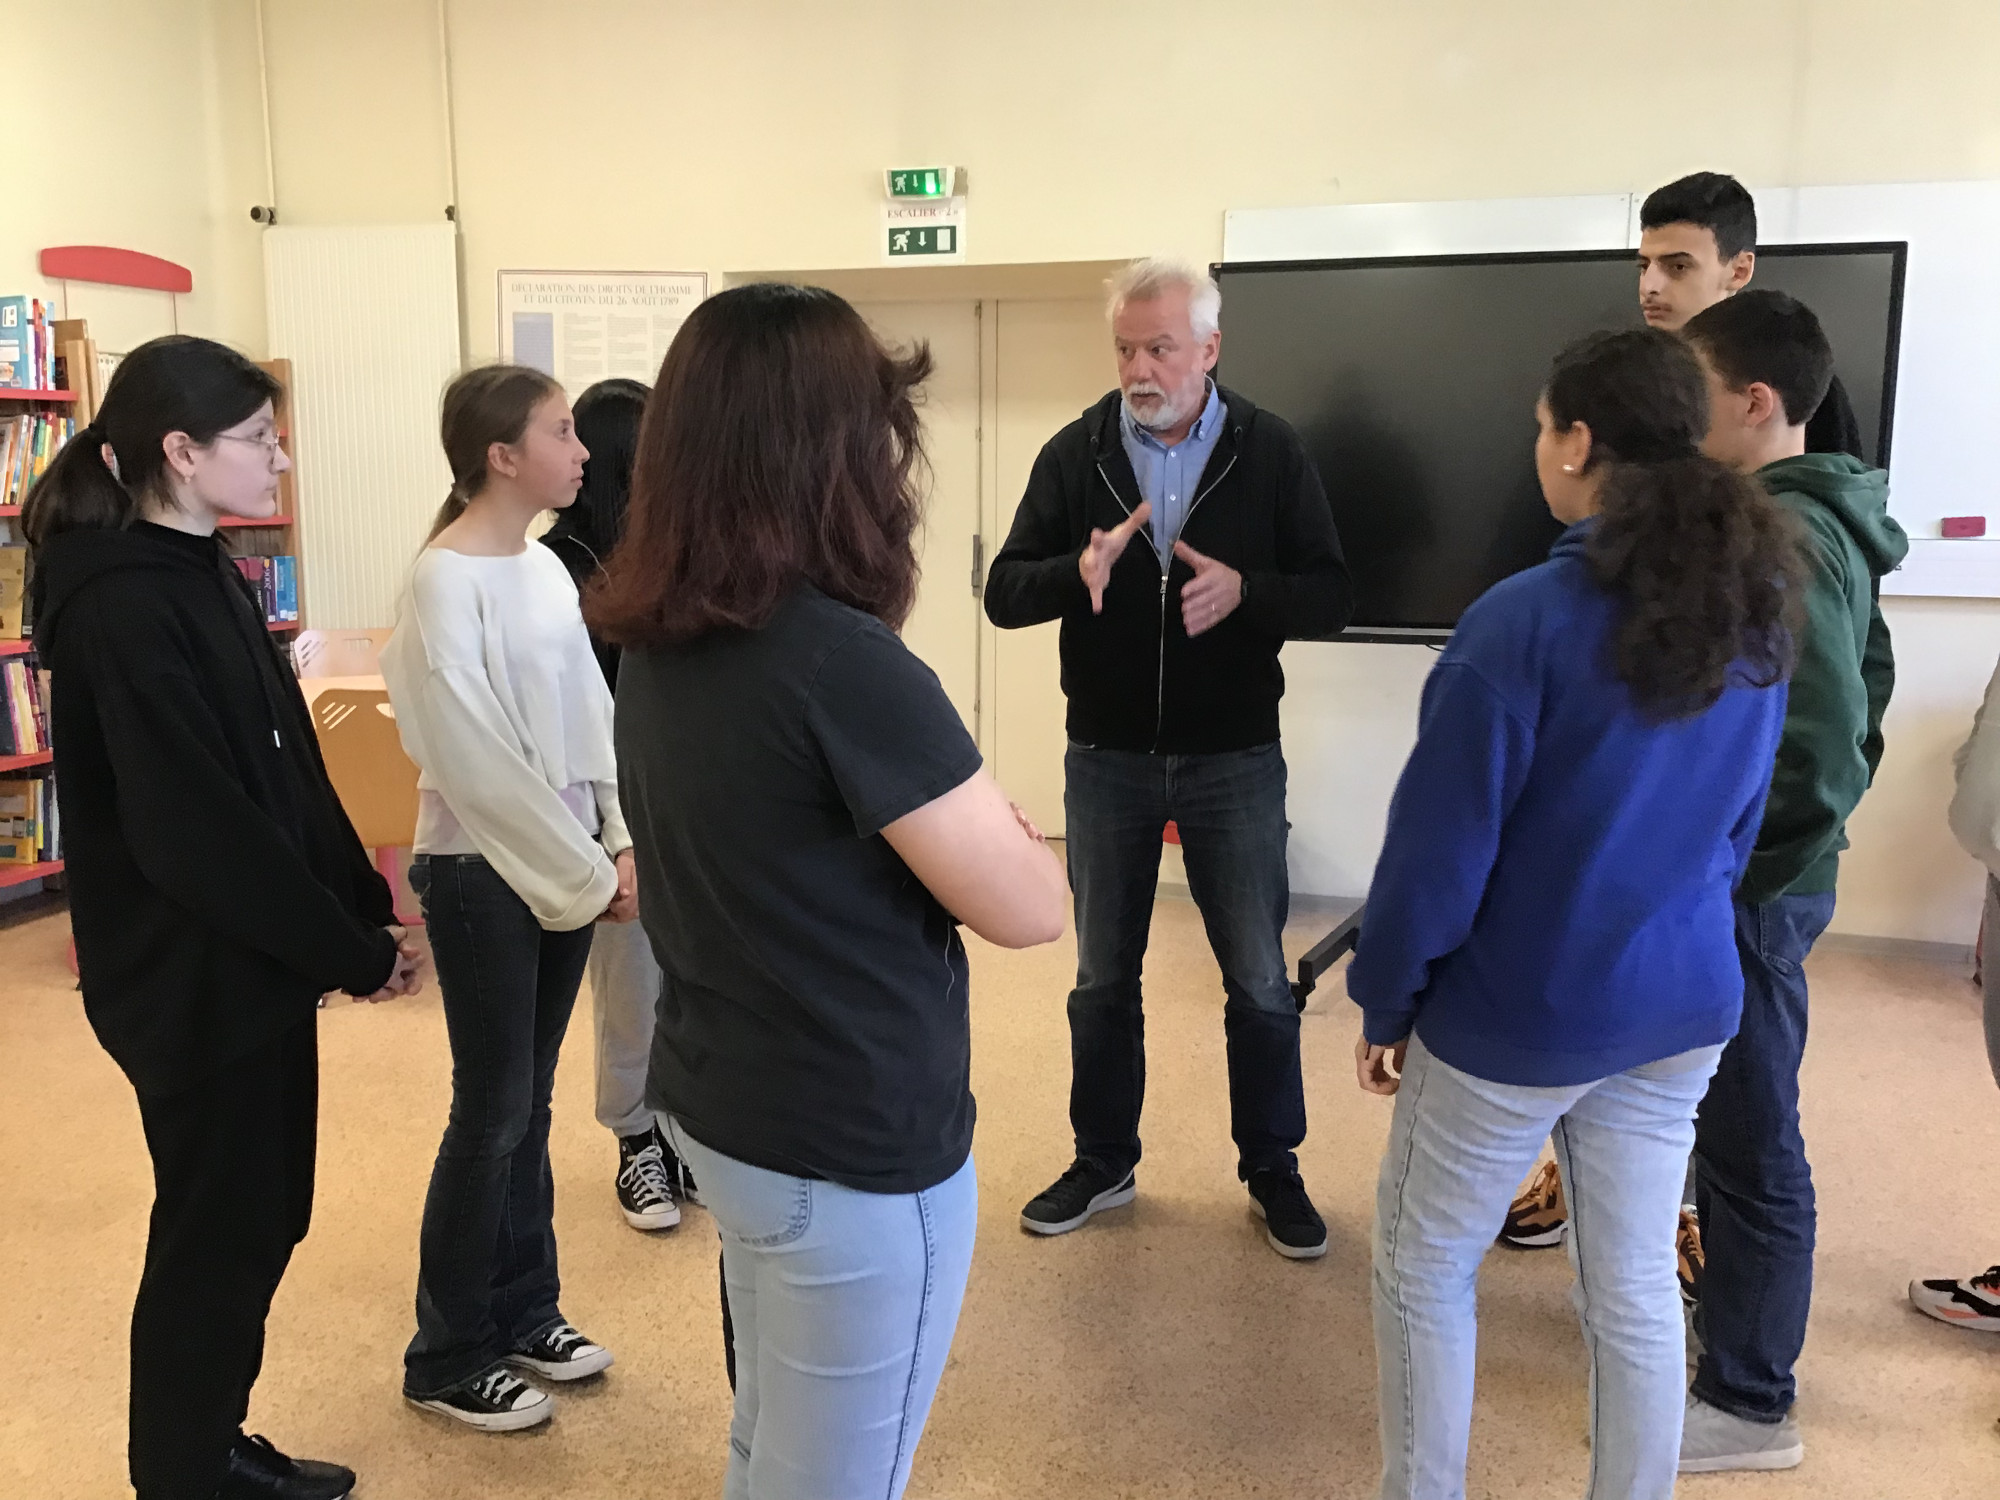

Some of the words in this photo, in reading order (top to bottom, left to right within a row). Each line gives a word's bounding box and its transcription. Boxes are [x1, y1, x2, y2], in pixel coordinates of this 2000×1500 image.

[887, 207, 936, 218] ESCALIER
[578, 284, 595, 294] DES
[597, 284, 632, 294] DROITS
[635, 284, 646, 294] DE
[524, 294, 534, 304] ET
[538, 294, 552, 304] DU
[555, 295, 596, 305] CITOYEN
[598, 295, 613, 305] DU
[617, 296, 628, 305] 26
[660, 296, 679, 306] 1789
[264, 568, 272, 590] 2006
